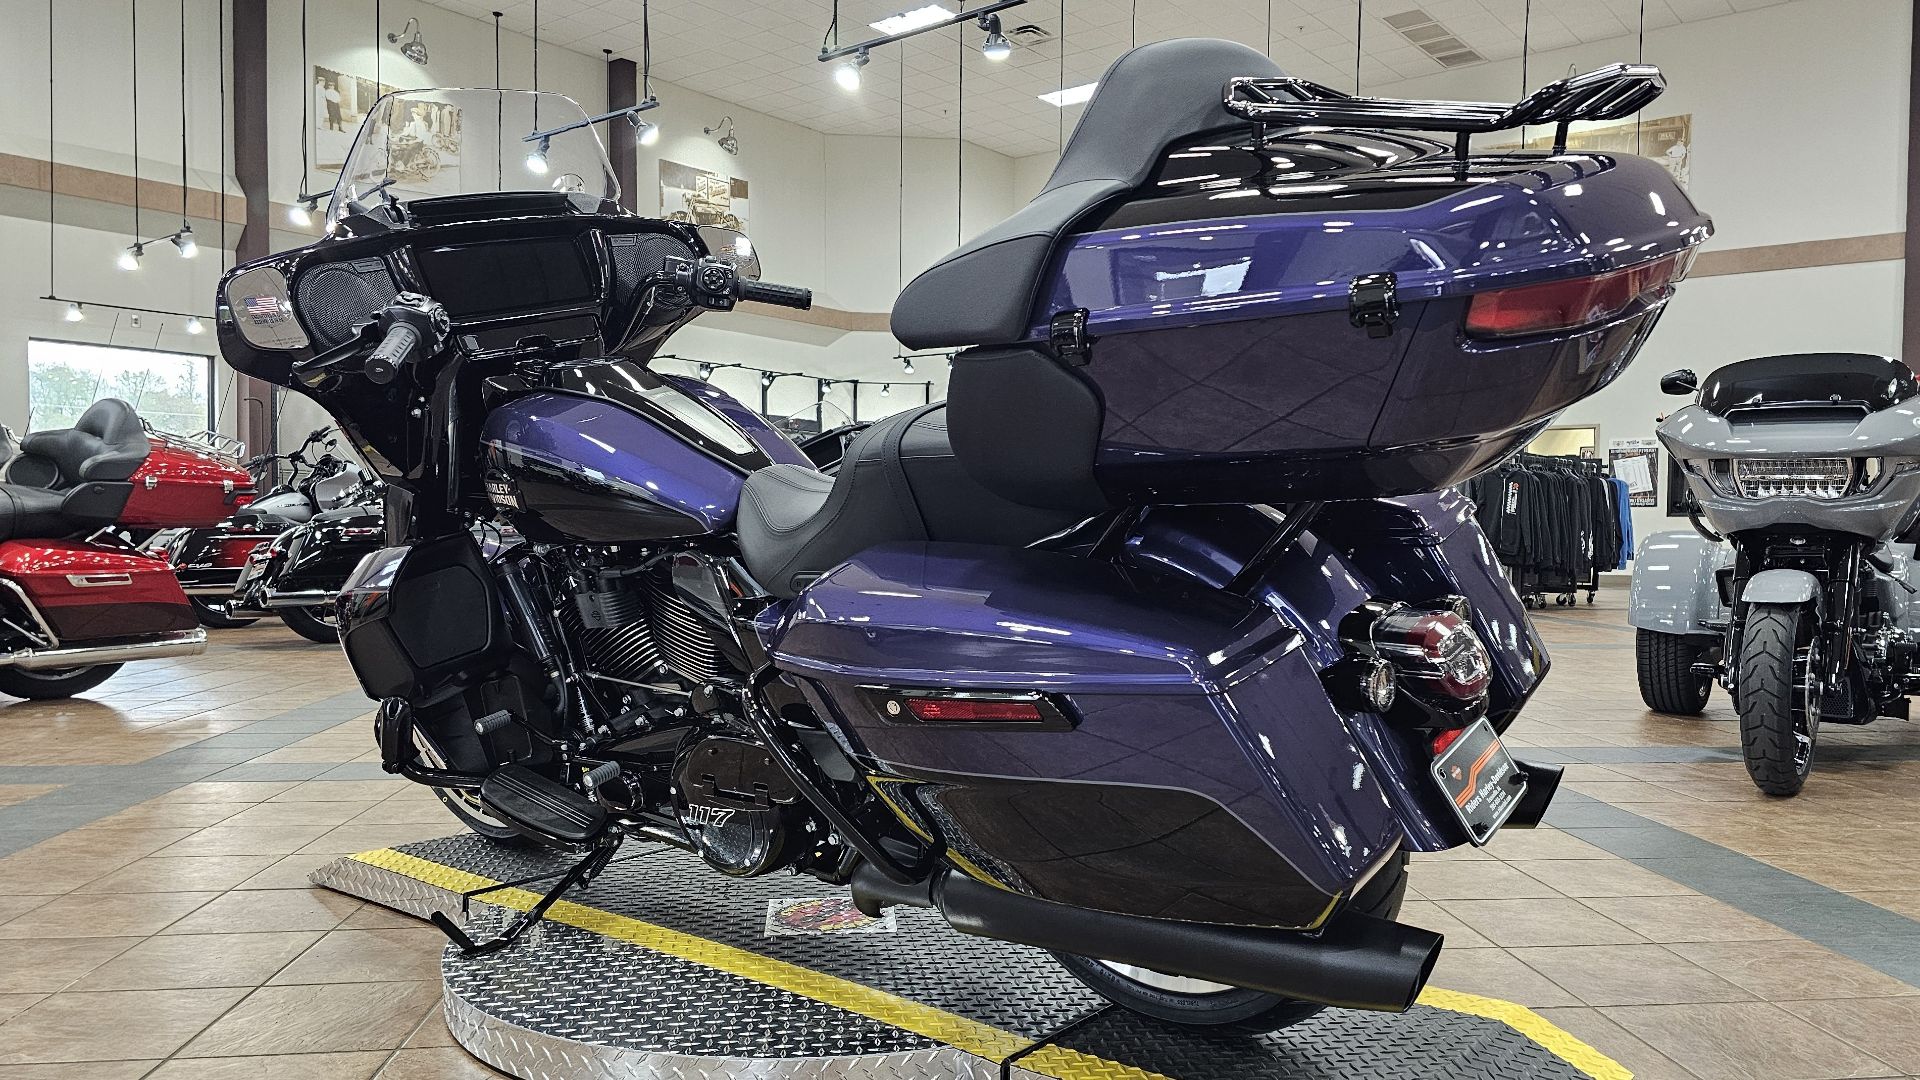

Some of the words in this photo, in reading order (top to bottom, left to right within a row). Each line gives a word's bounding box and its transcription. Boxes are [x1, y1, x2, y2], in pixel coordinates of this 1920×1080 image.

[1465, 796, 1482, 814] Riders
[1478, 762, 1510, 799] Harley-Davidson
[688, 803, 735, 827] 117
